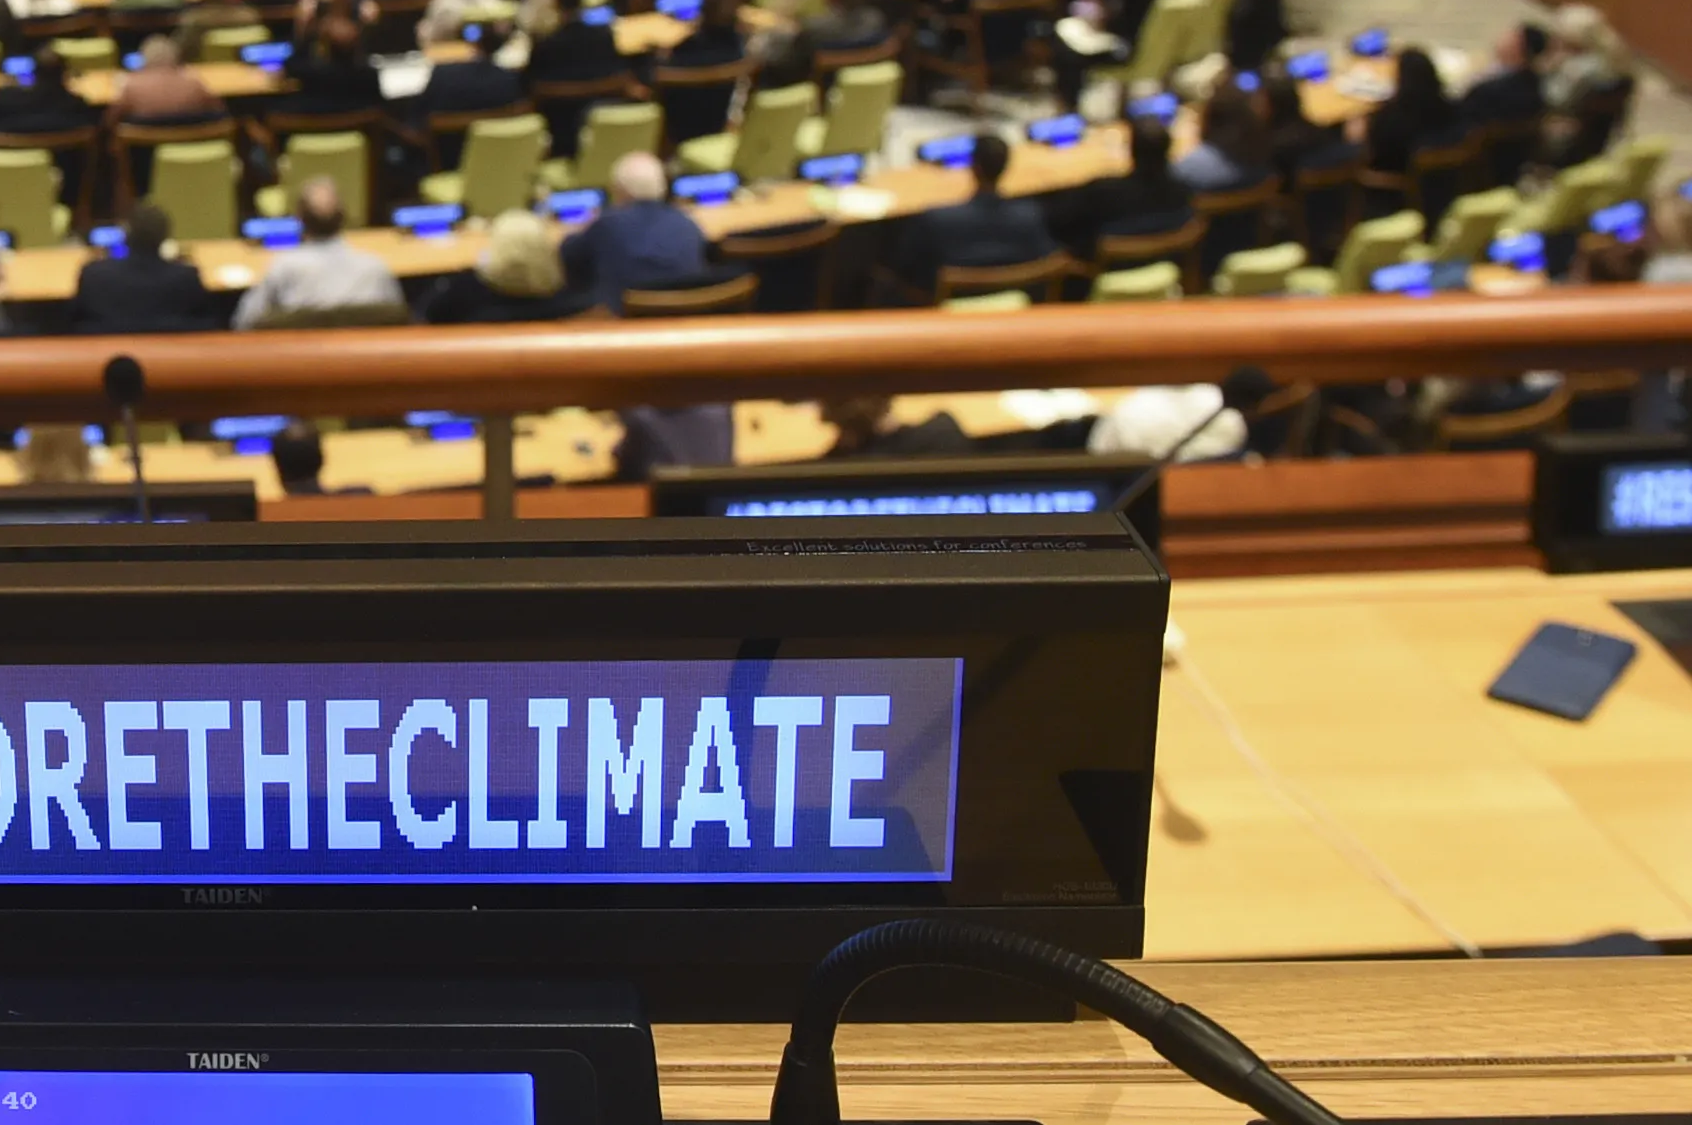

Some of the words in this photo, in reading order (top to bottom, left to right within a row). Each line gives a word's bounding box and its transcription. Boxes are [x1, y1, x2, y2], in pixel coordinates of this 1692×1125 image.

[746, 541, 838, 552] Excellent
[843, 540, 928, 551] solutions
[934, 539, 961, 551] for
[969, 538, 1088, 550] conferences
